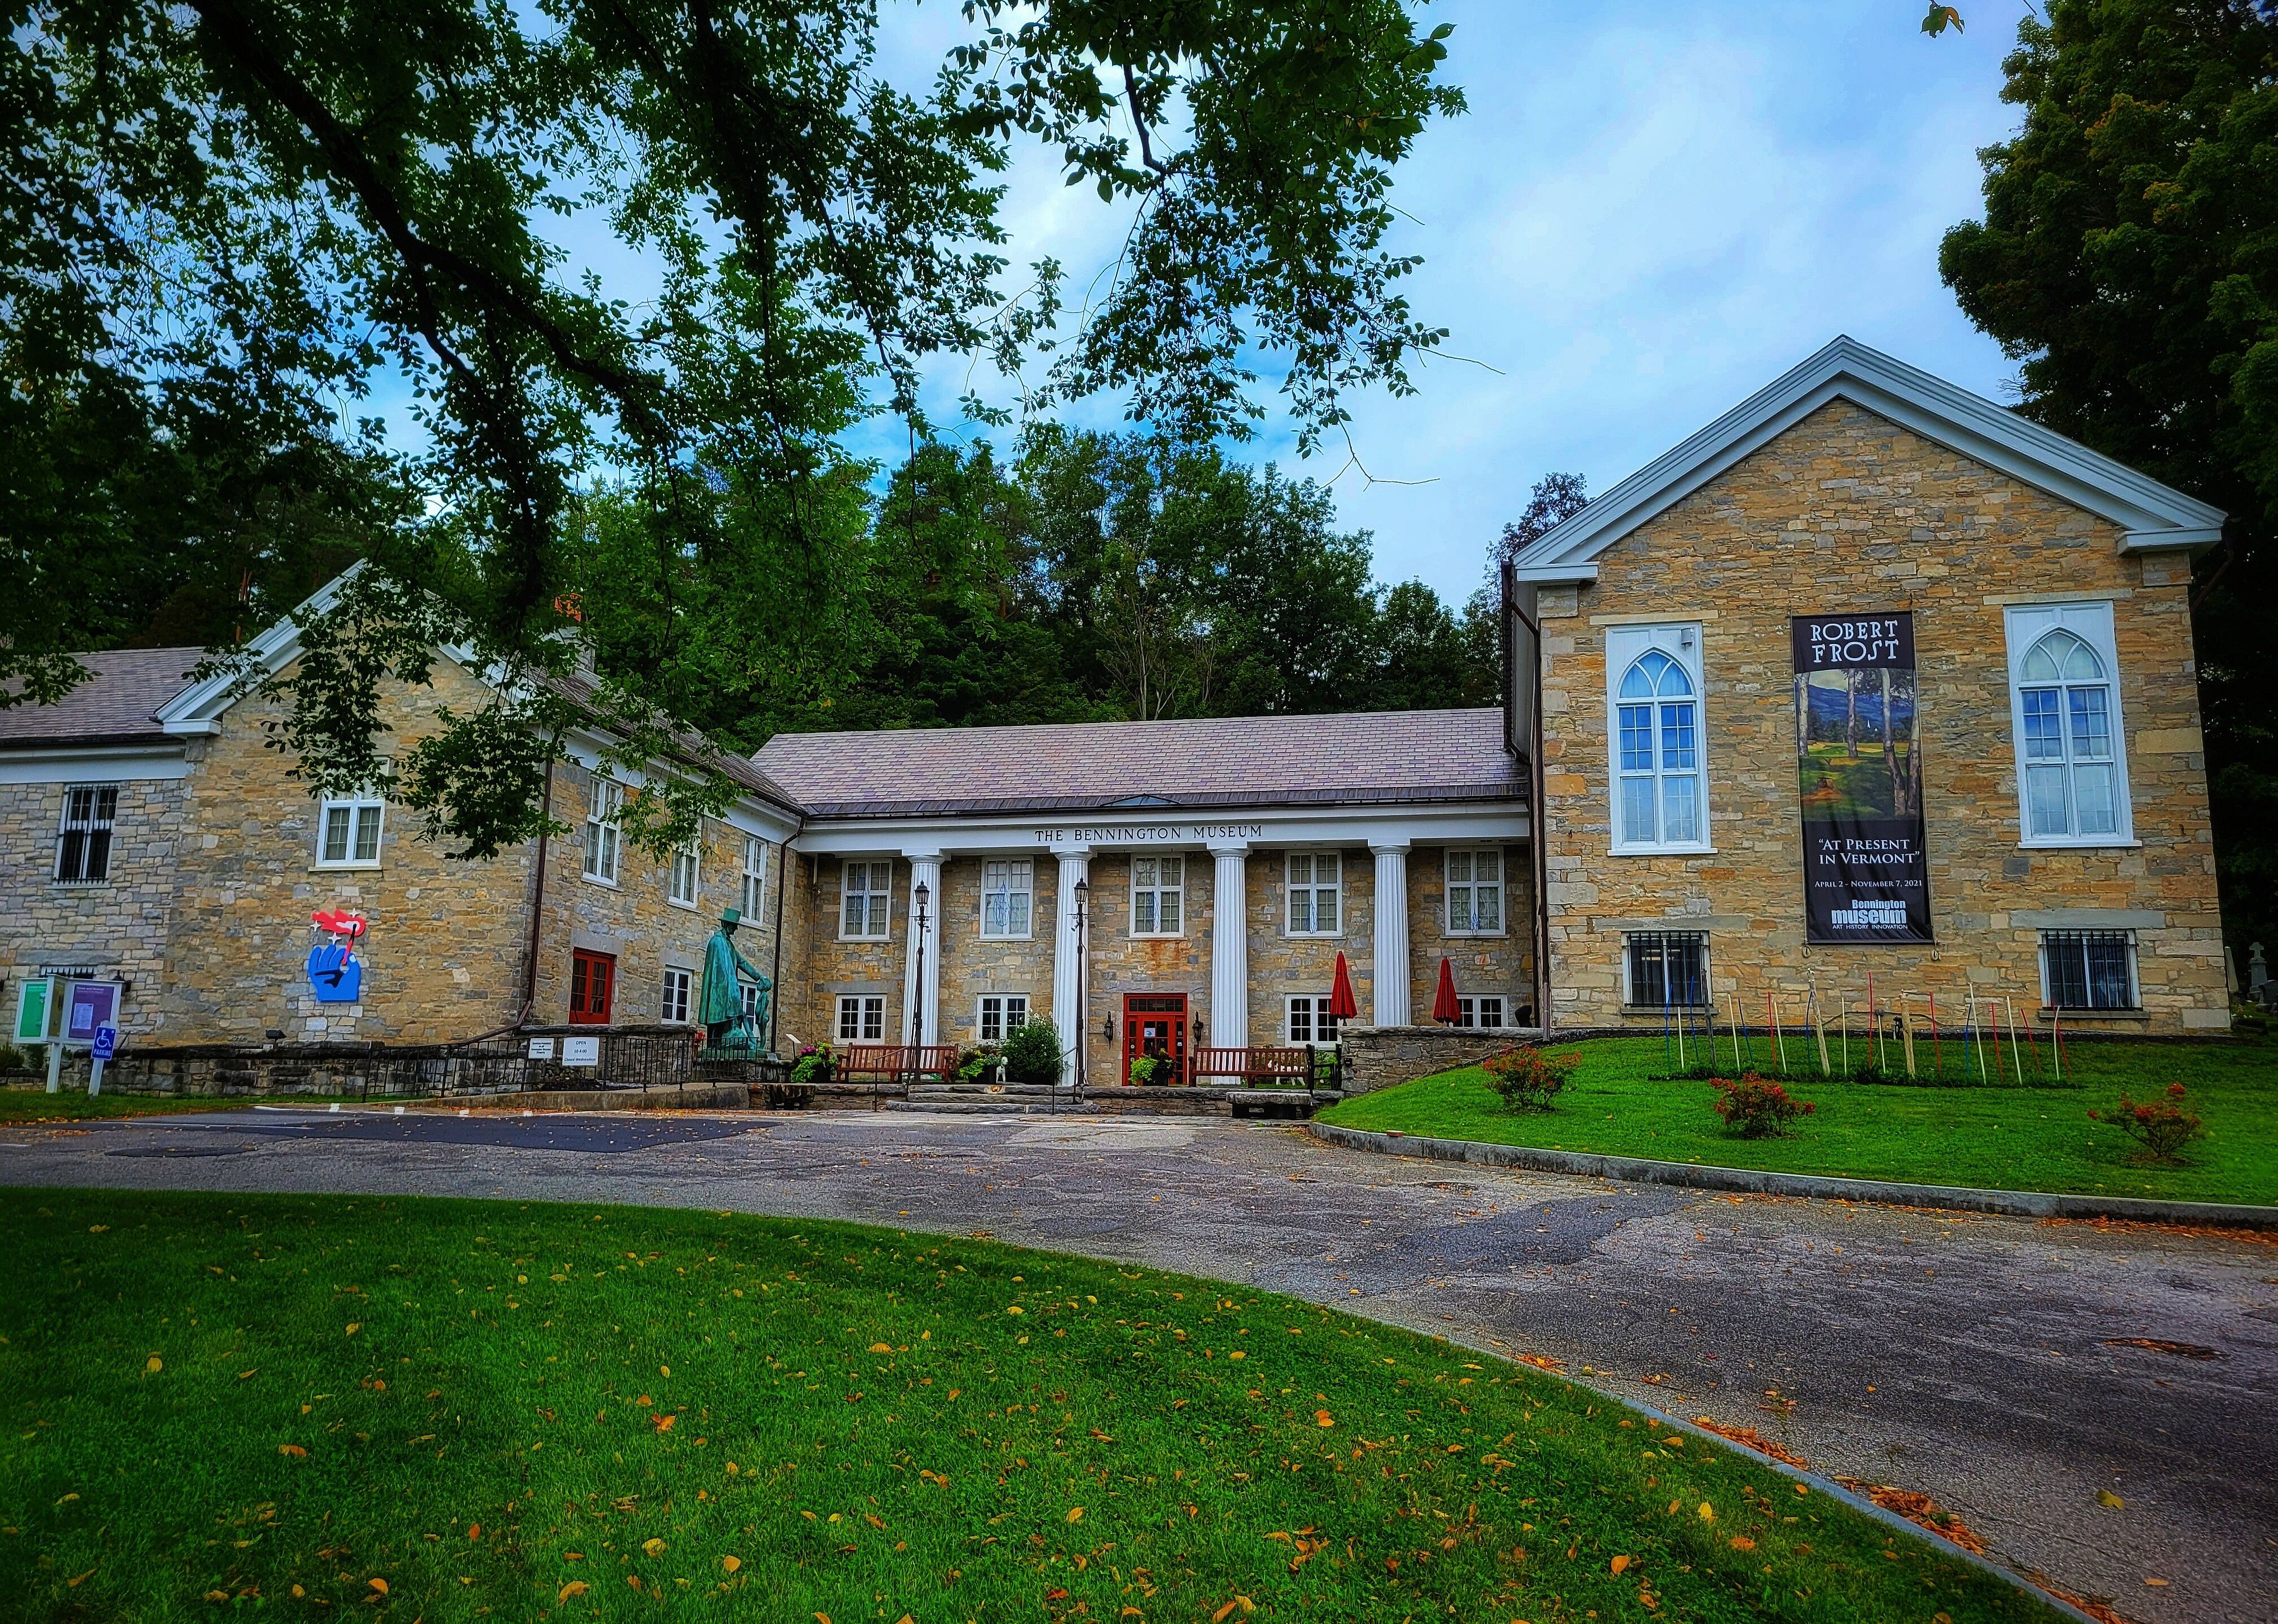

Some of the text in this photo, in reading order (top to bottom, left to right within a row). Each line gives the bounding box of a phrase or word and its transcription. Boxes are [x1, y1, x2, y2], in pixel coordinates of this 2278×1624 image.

[1810, 619, 1898, 642] ROBERT
[1811, 639, 1899, 663] FROST
[1034, 825, 1262, 842] THE BENNINGTON MUSEUM
[1845, 838, 1910, 850] PRESENT
[1819, 854, 1836, 864] IN
[1852, 899, 1906, 909] Bennington
[1831, 909, 1907, 924] museum
